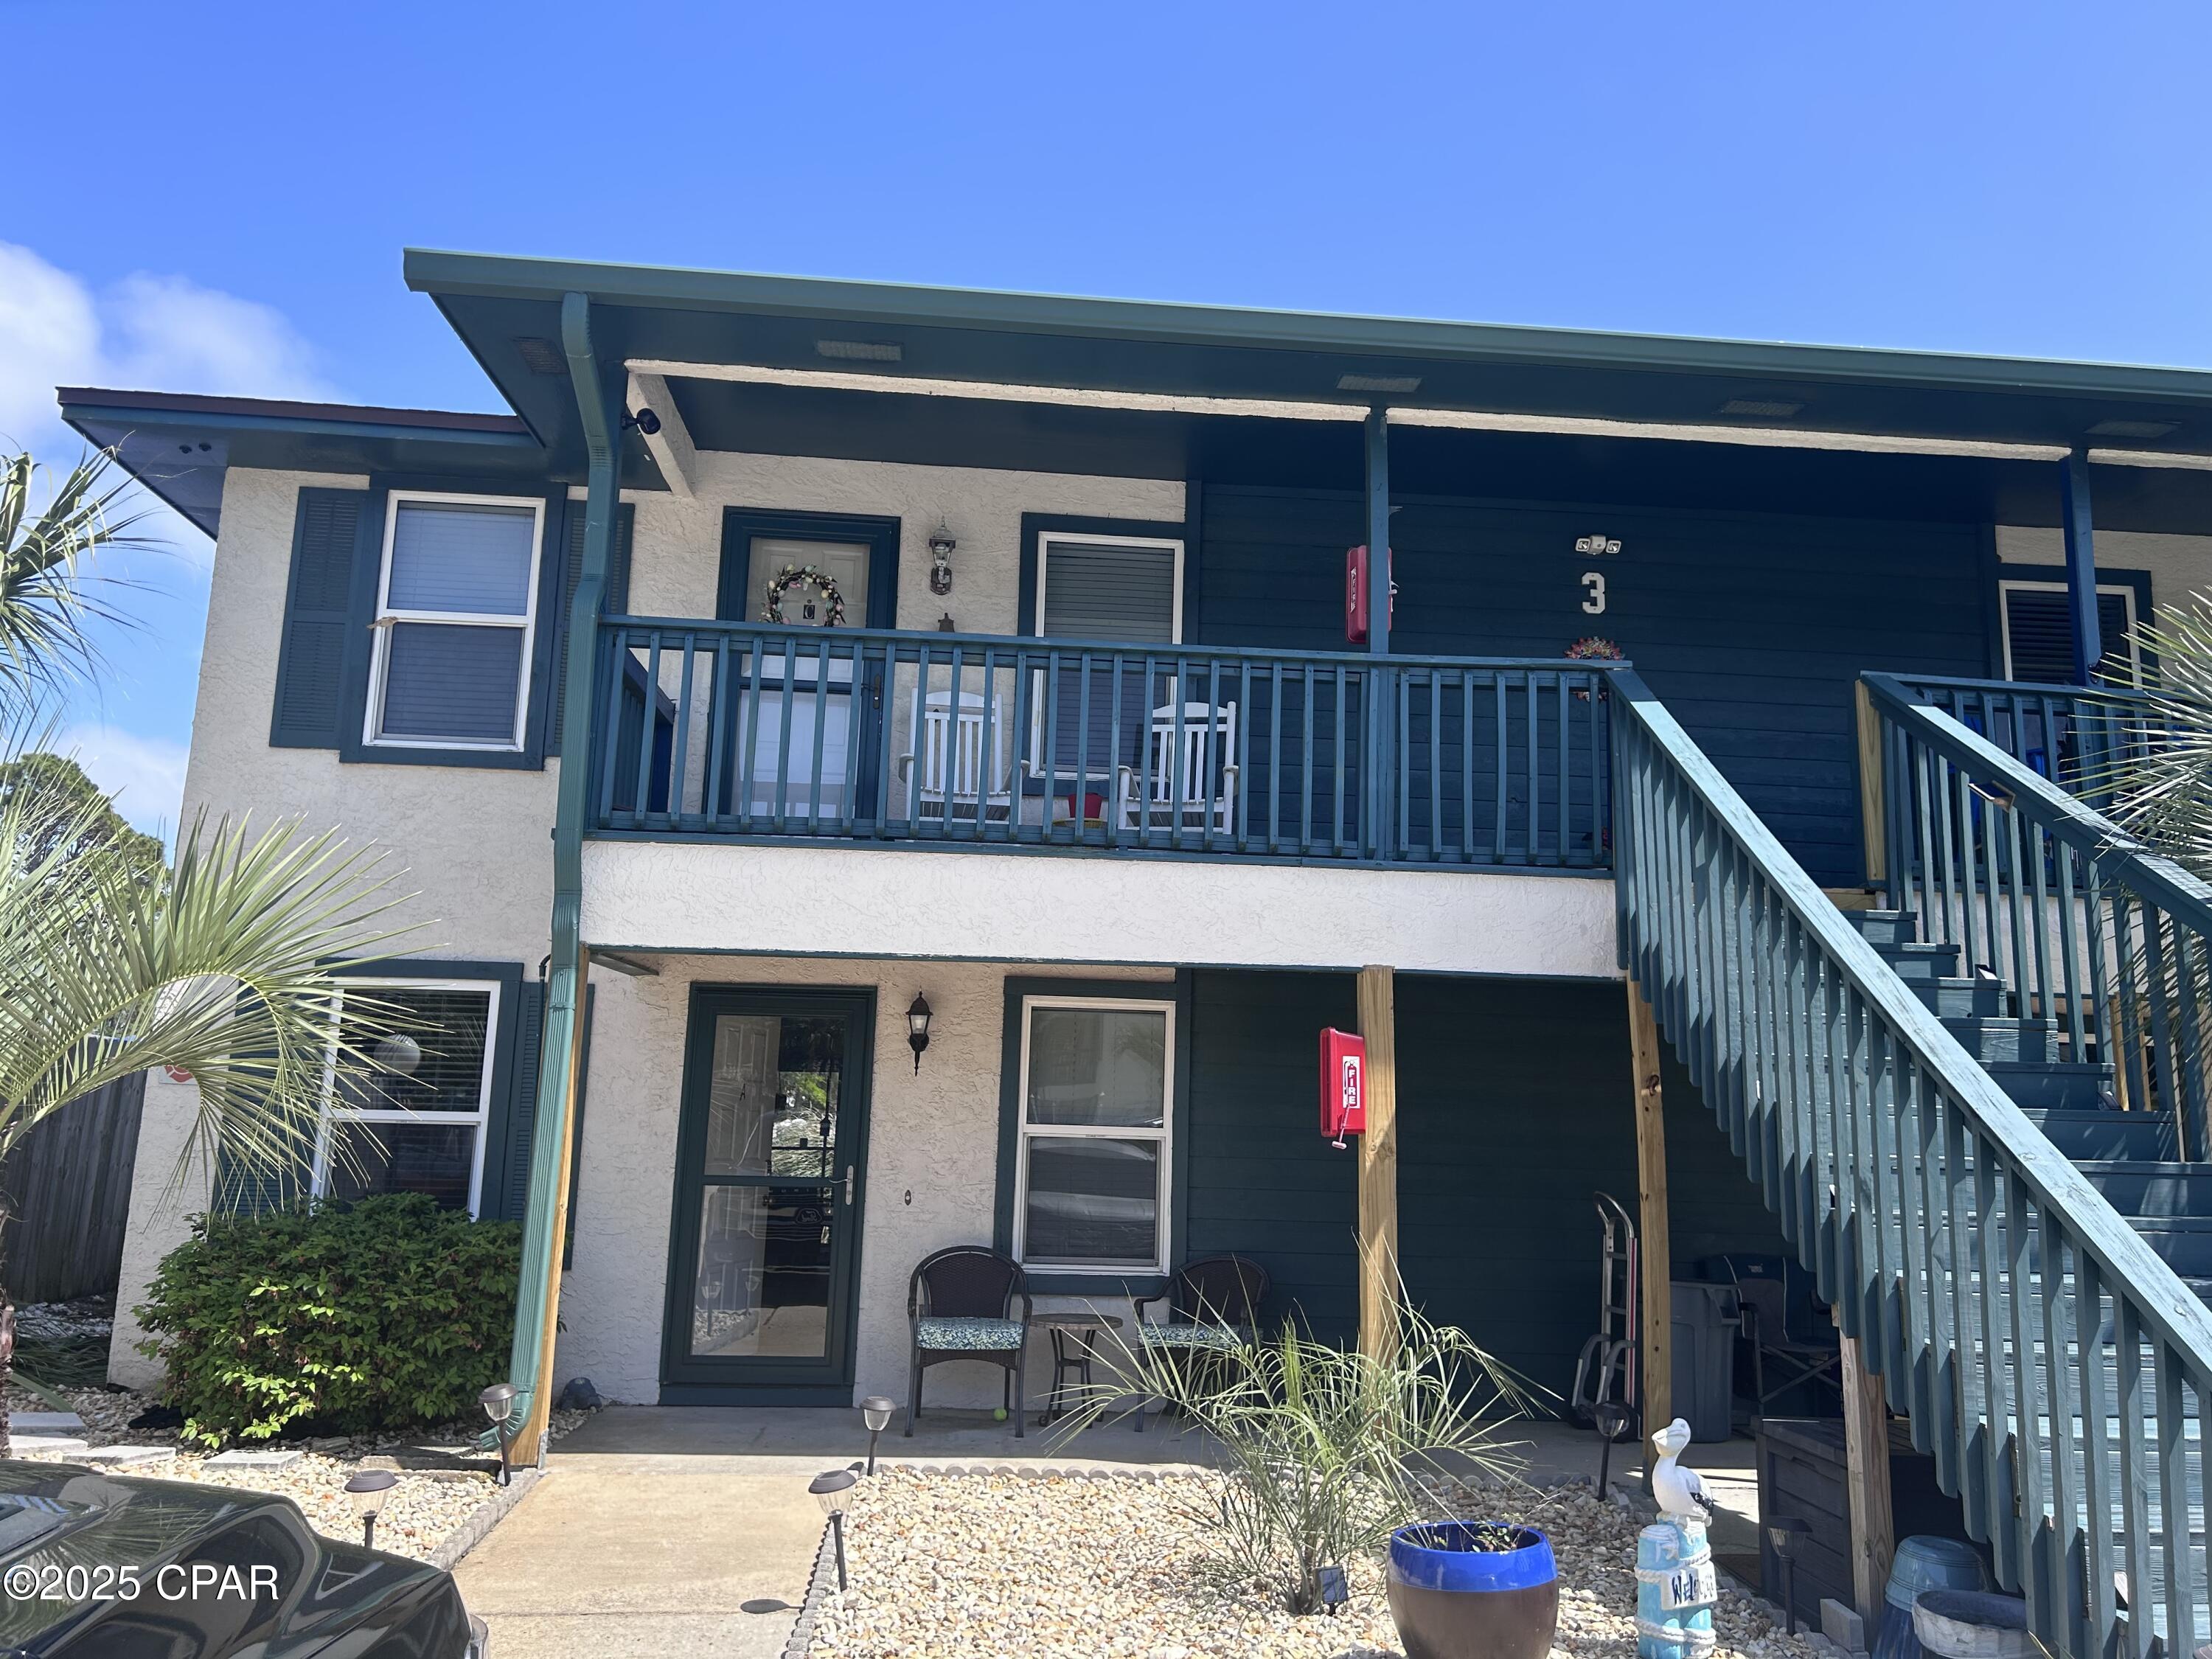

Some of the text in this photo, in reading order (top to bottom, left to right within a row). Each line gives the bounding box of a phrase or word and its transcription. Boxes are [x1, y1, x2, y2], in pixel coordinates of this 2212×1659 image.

[1582, 571, 1606, 614] 3
[1348, 1068, 1357, 1105] FIRE
[1671, 1572, 1714, 1606] WELC
